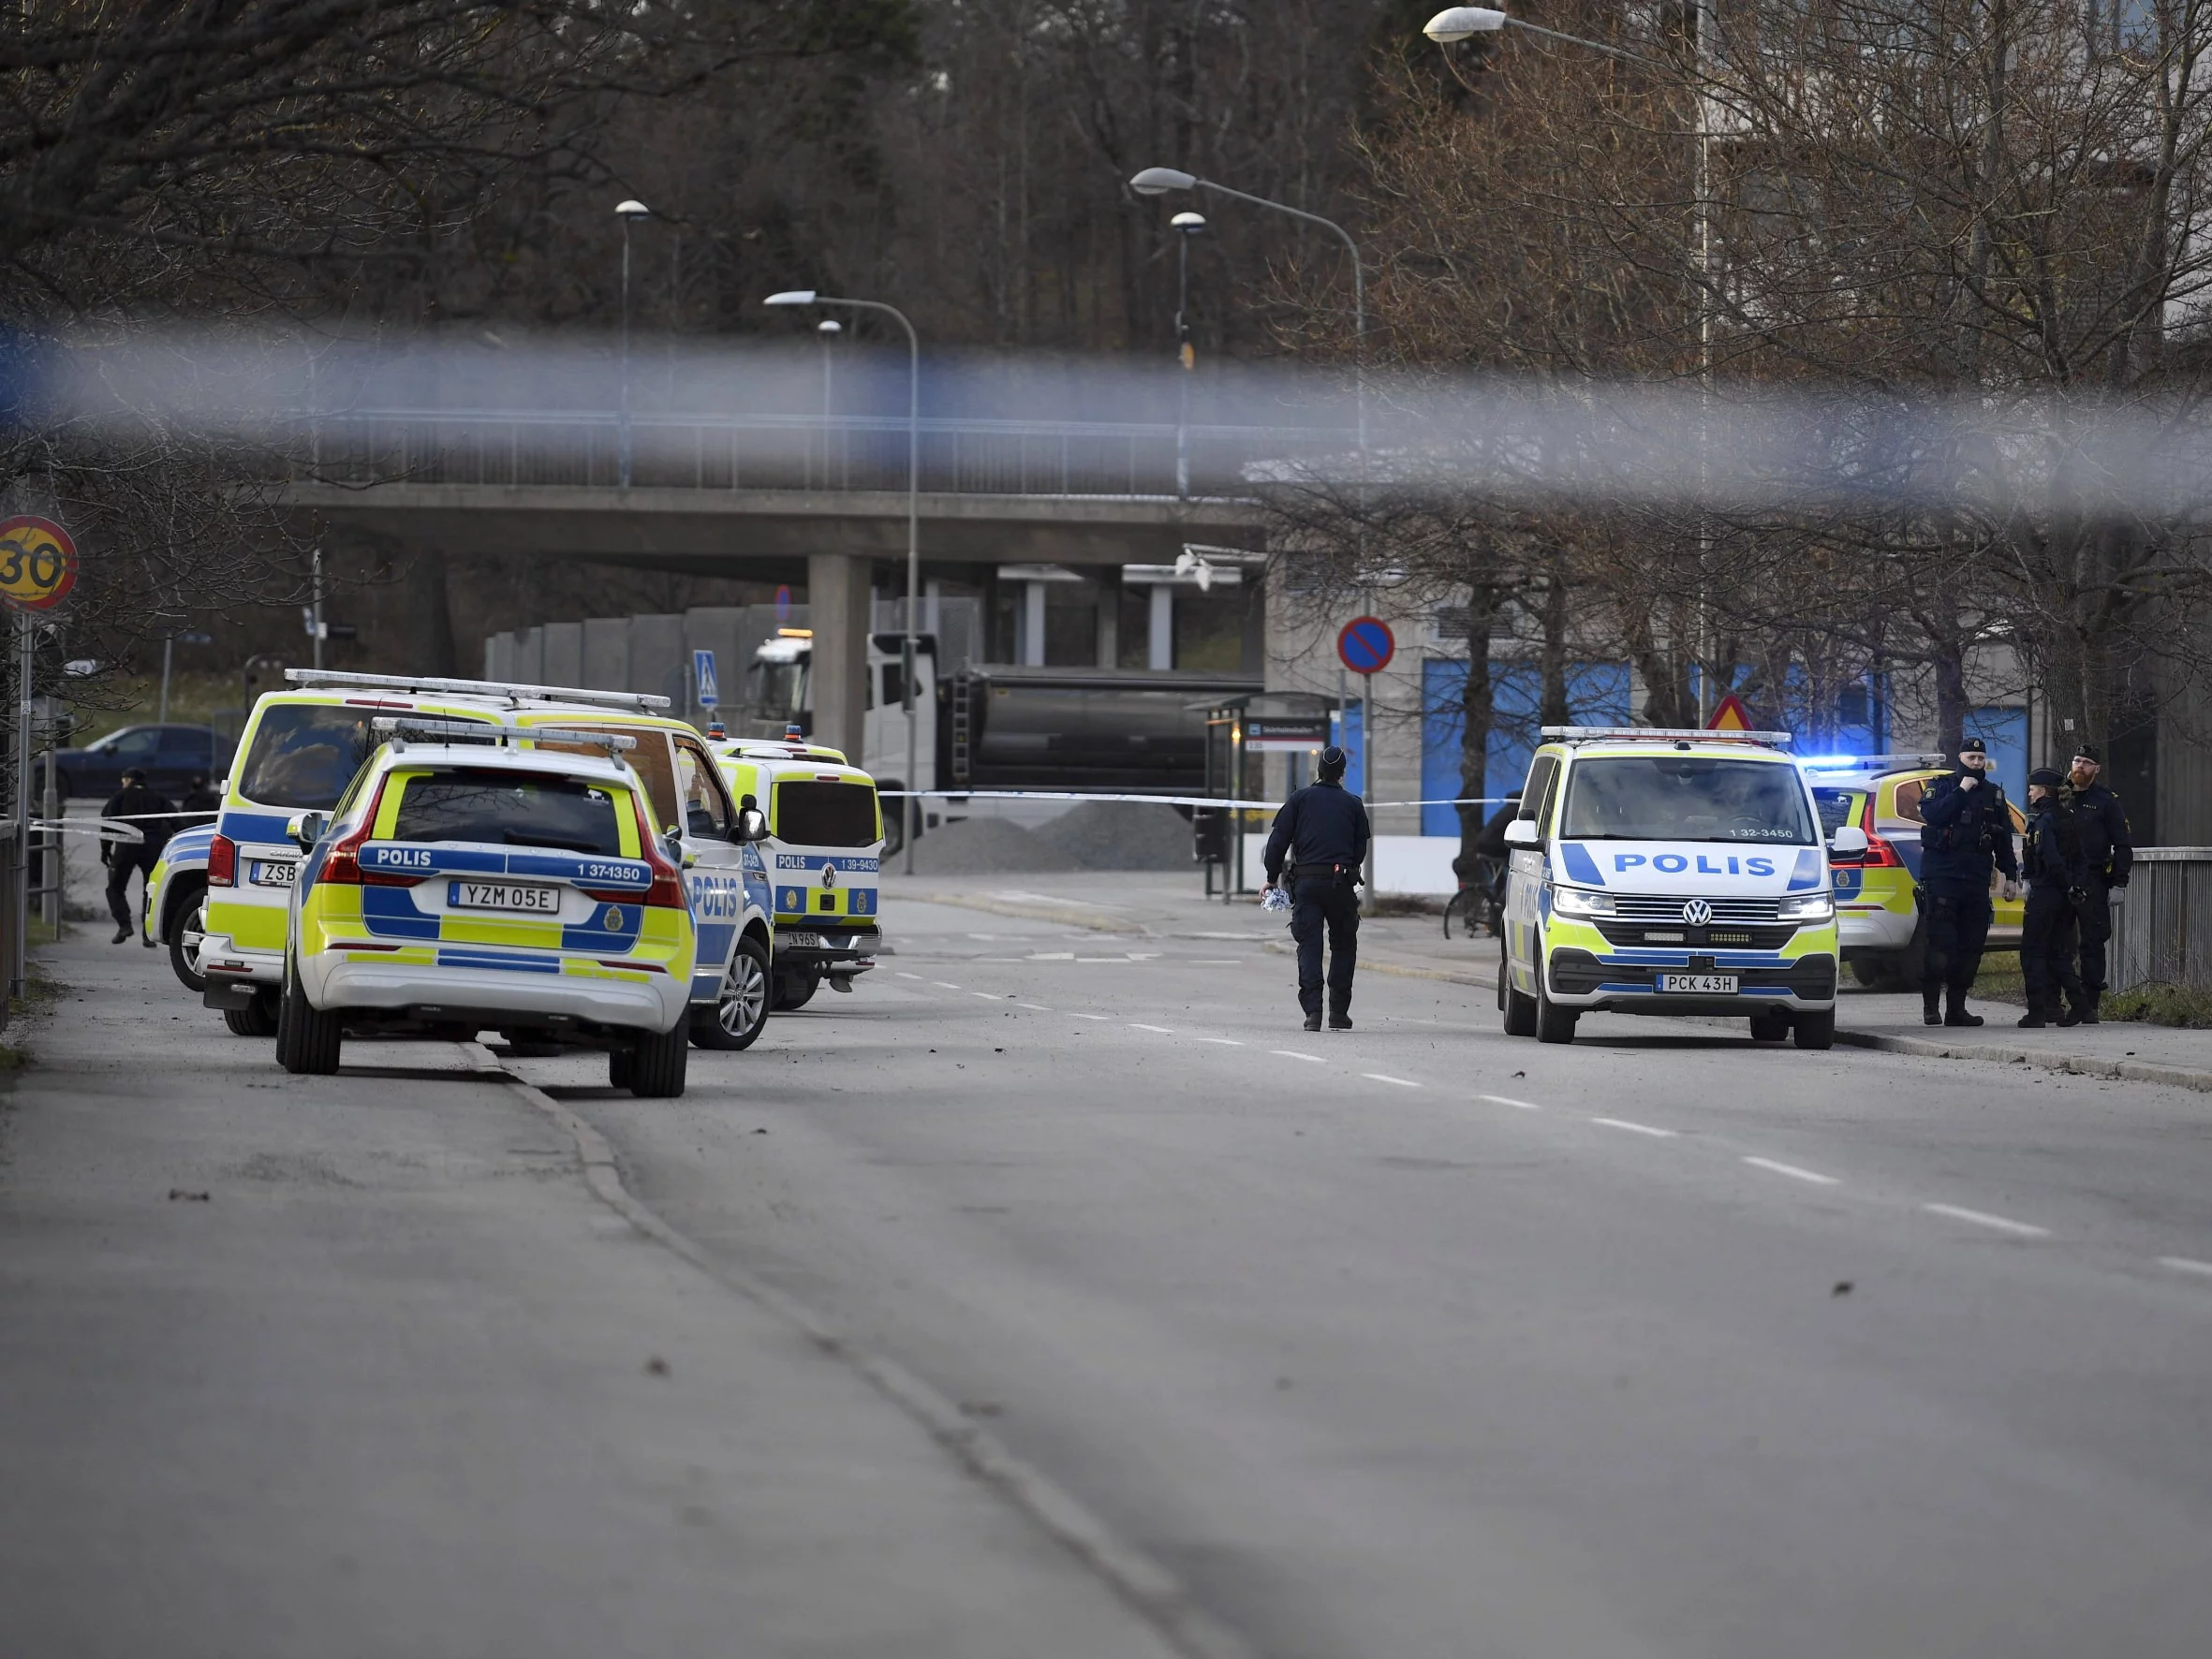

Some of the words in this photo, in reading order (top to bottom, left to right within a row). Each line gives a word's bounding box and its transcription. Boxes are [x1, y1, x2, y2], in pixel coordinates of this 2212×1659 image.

[0, 540, 62, 588] 30
[1741, 829, 1792, 838] 32-3450
[377, 849, 431, 866] POLIS
[778, 855, 805, 869] POLIS
[841, 860, 846, 869] 1
[847, 859, 878, 871] 39-9430
[1614, 854, 1775, 876] POLIS
[265, 865, 296, 881] ZSB
[578, 863, 584, 876] 1
[589, 864, 640, 880] 37-1350
[467, 886, 505, 904] YZM
[512, 888, 550, 908] 05E
[693, 876, 737, 918] POLIS
[1669, 976, 1697, 990] PCK
[1703, 976, 1732, 991] 43H
